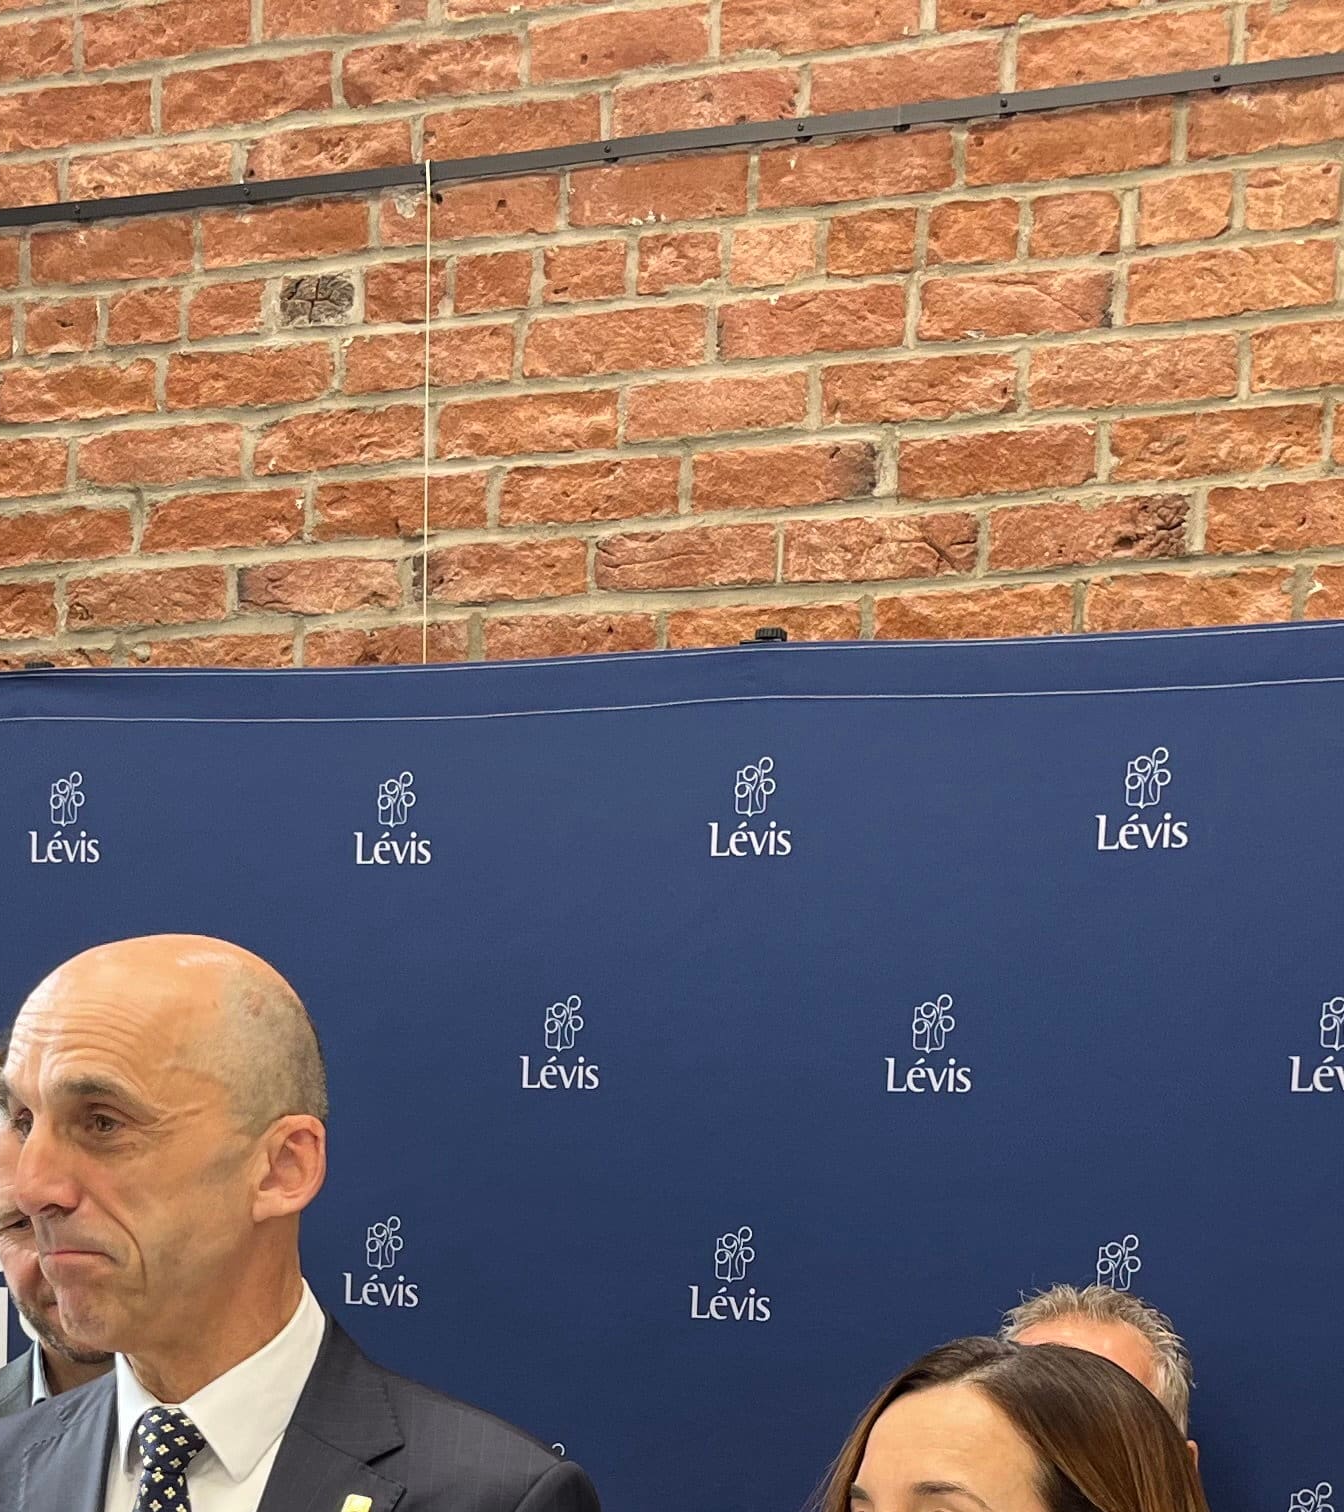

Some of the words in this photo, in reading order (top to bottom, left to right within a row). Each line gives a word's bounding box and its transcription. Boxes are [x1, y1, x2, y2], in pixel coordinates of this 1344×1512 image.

[29, 830, 100, 865] Lévis
[353, 832, 432, 866] Lévis
[708, 821, 792, 858] Lévis
[1096, 814, 1189, 851] Lévis
[519, 1055, 600, 1091] Lévis
[884, 1056, 972, 1094] Lévis
[342, 1271, 419, 1309] Lévis
[689, 1284, 772, 1323] Lévis
